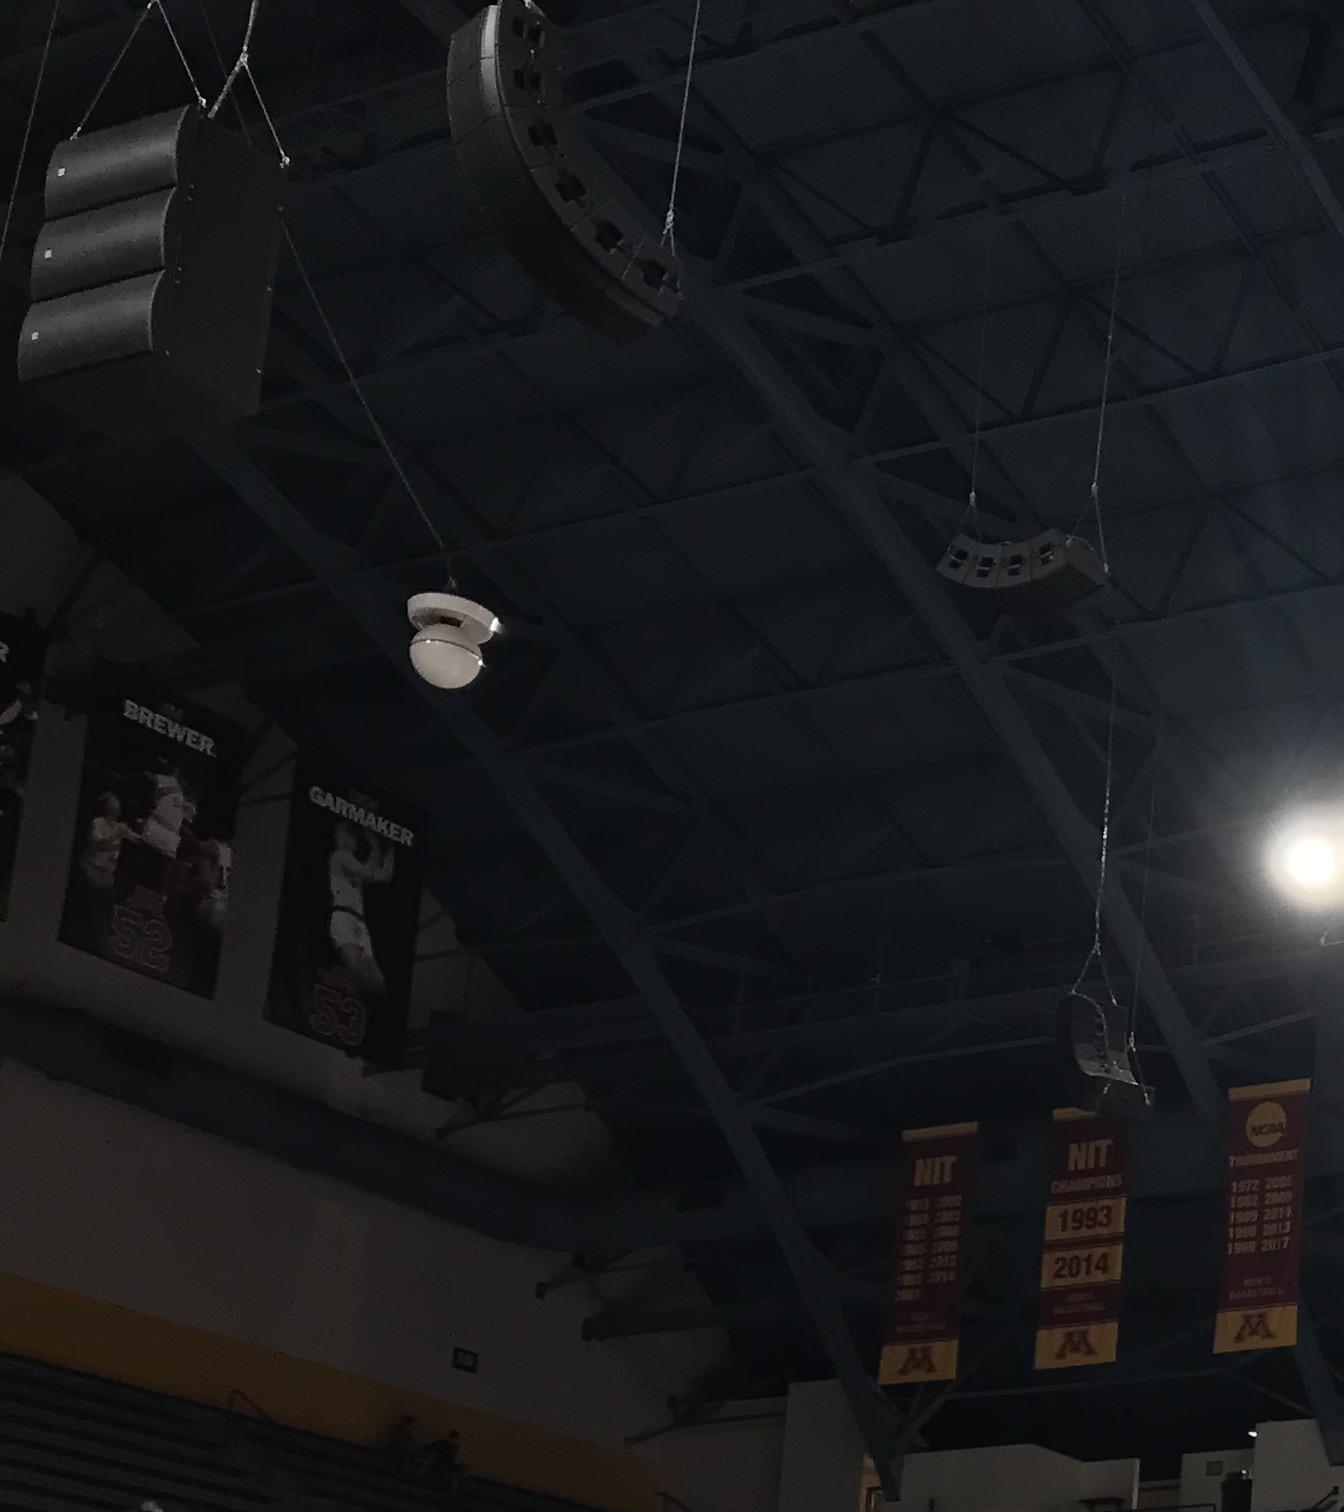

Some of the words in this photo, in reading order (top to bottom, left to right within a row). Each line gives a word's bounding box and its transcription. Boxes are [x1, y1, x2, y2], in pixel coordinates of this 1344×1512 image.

[122, 699, 217, 758] BREWER
[309, 785, 416, 848] GARMAKER
[913, 1155, 958, 1186] NIT
[1067, 1139, 1113, 1172] NIT
[1059, 1205, 1112, 1233] 1993
[1053, 1253, 1108, 1280] 2014
